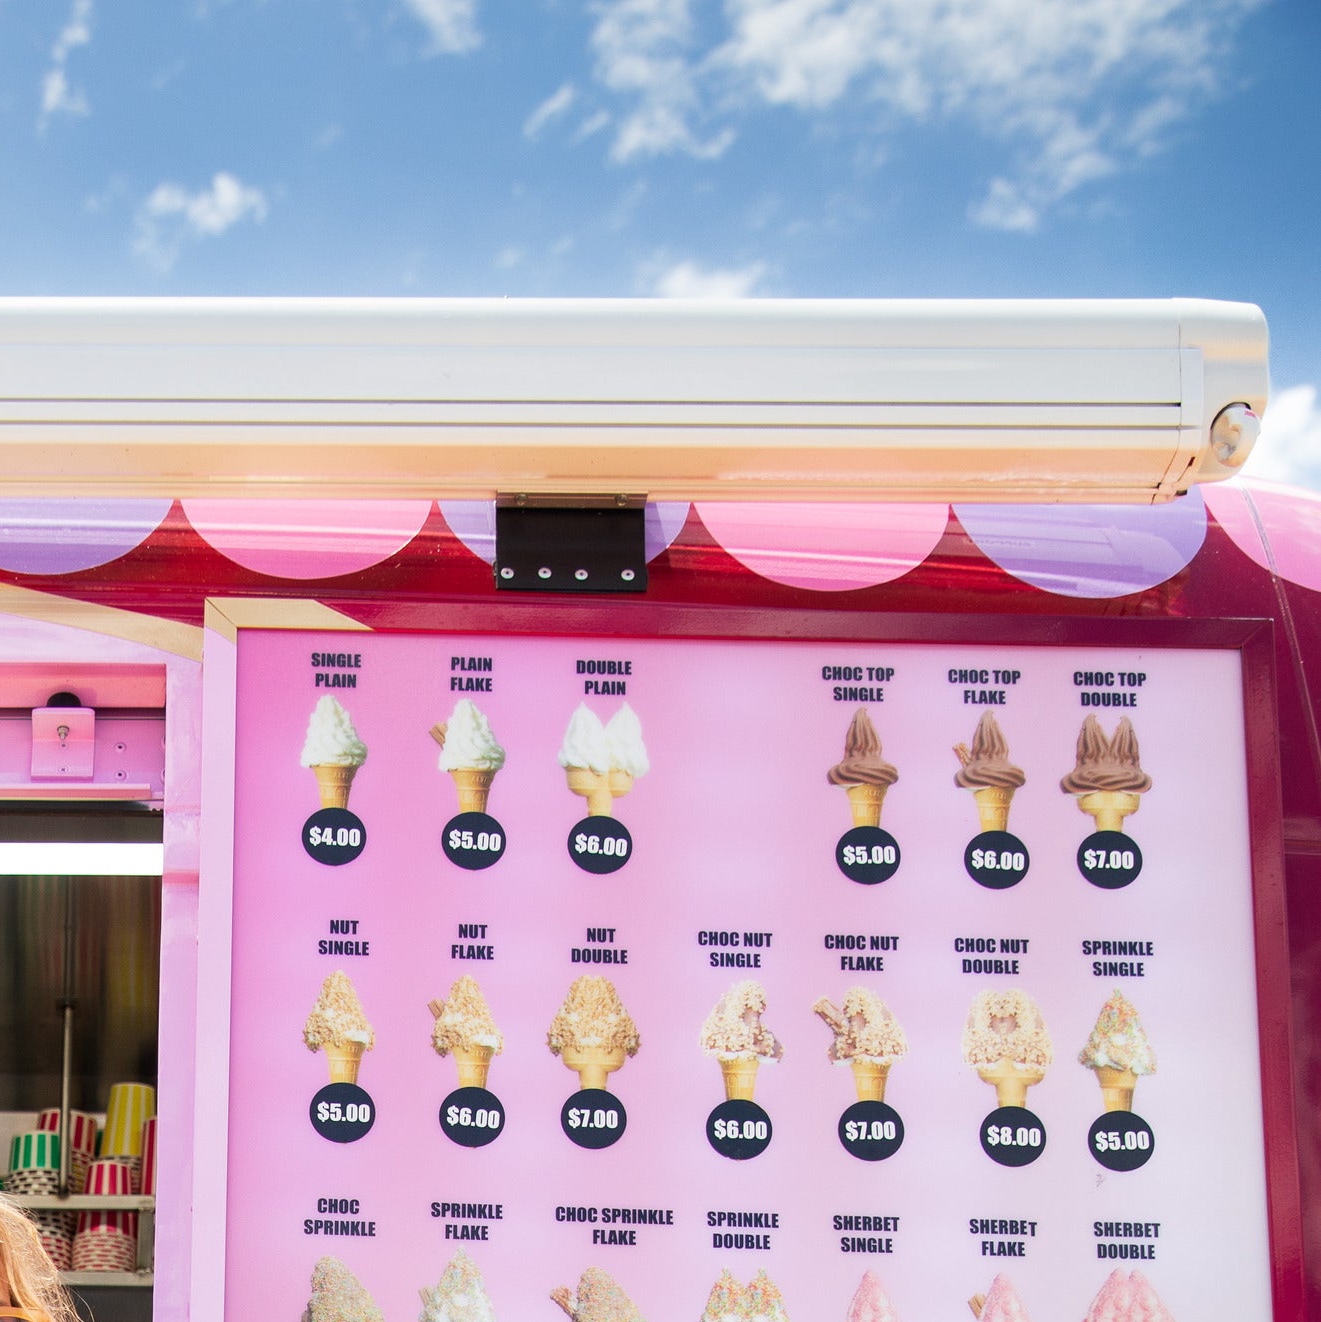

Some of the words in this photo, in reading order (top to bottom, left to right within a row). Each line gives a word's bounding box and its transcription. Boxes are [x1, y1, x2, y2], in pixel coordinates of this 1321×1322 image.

[311, 653, 361, 668] SINGLE
[451, 657, 492, 671] PLAIN
[577, 660, 632, 675] DOUBLE
[315, 673, 356, 688] PLAIN
[822, 666, 862, 681] CHOC
[866, 668, 894, 681] TOP
[948, 669, 988, 684] CHOC
[993, 670, 1020, 684] TOP
[1074, 672, 1114, 686] CHOC
[1118, 673, 1146, 686] TOP
[451, 677, 492, 692] FLAKE
[585, 681, 626, 695] PLAIN
[833, 687, 883, 701] SINGLE
[964, 690, 1005, 704] FLAKE
[1081, 692, 1136, 707] DOUBLE
[310, 826, 360, 846] $4.00
[449, 829, 501, 851] $5.00
[575, 833, 627, 856] $6.00
[843, 845, 895, 865] $5.00
[972, 849, 1024, 870] $6.00
[1085, 849, 1134, 869] $7.00
[330, 920, 359, 934] NUT
[459, 924, 487, 939] NUT
[587, 928, 616, 942] NUT
[698, 931, 739, 946] CHOC
[744, 933, 772, 947] NUT
[825, 935, 866, 950] CHOC
[870, 936, 899, 950] NUT
[319, 940, 369, 956] SINGLE
[452, 945, 494, 960] FLAKE
[955, 938, 996, 953] CHOC
[1000, 939, 1029, 953] NUT
[1082, 941, 1153, 955] SPRINKLE
[572, 949, 627, 964] DOUBLE
[710, 953, 761, 968] SINGLE
[841, 956, 883, 971] FLAKE
[963, 959, 1019, 974] DOUBLE
[1093, 962, 1144, 976] SINGLE
[318, 1102, 370, 1122] $5.00
[447, 1105, 500, 1128] $6.00
[569, 1108, 618, 1128] $7.00
[714, 1119, 767, 1139] $6.00
[846, 1121, 895, 1141] $7.00
[988, 1125, 1040, 1146] $8.00
[1096, 1131, 1149, 1152] $5.00
[318, 1198, 359, 1214] CHOC
[431, 1202, 502, 1219] SPRINKLE
[556, 1207, 597, 1222] CHOC
[602, 1208, 673, 1225] SPRINKLE
[708, 1212, 779, 1228] SPRINKLE
[833, 1215, 899, 1231] SHERBET
[304, 1220, 375, 1236] SPRINKLE
[446, 1225, 488, 1240] FLAKE
[970, 1219, 1037, 1236] SHERBET
[1094, 1222, 1160, 1237] SHERBET
[593, 1230, 636, 1245] FLAKE
[713, 1234, 770, 1249] DOUBLE
[841, 1237, 892, 1253] SINGLE
[982, 1241, 1025, 1256] FLAKE
[1098, 1244, 1155, 1259] DOUBLE
